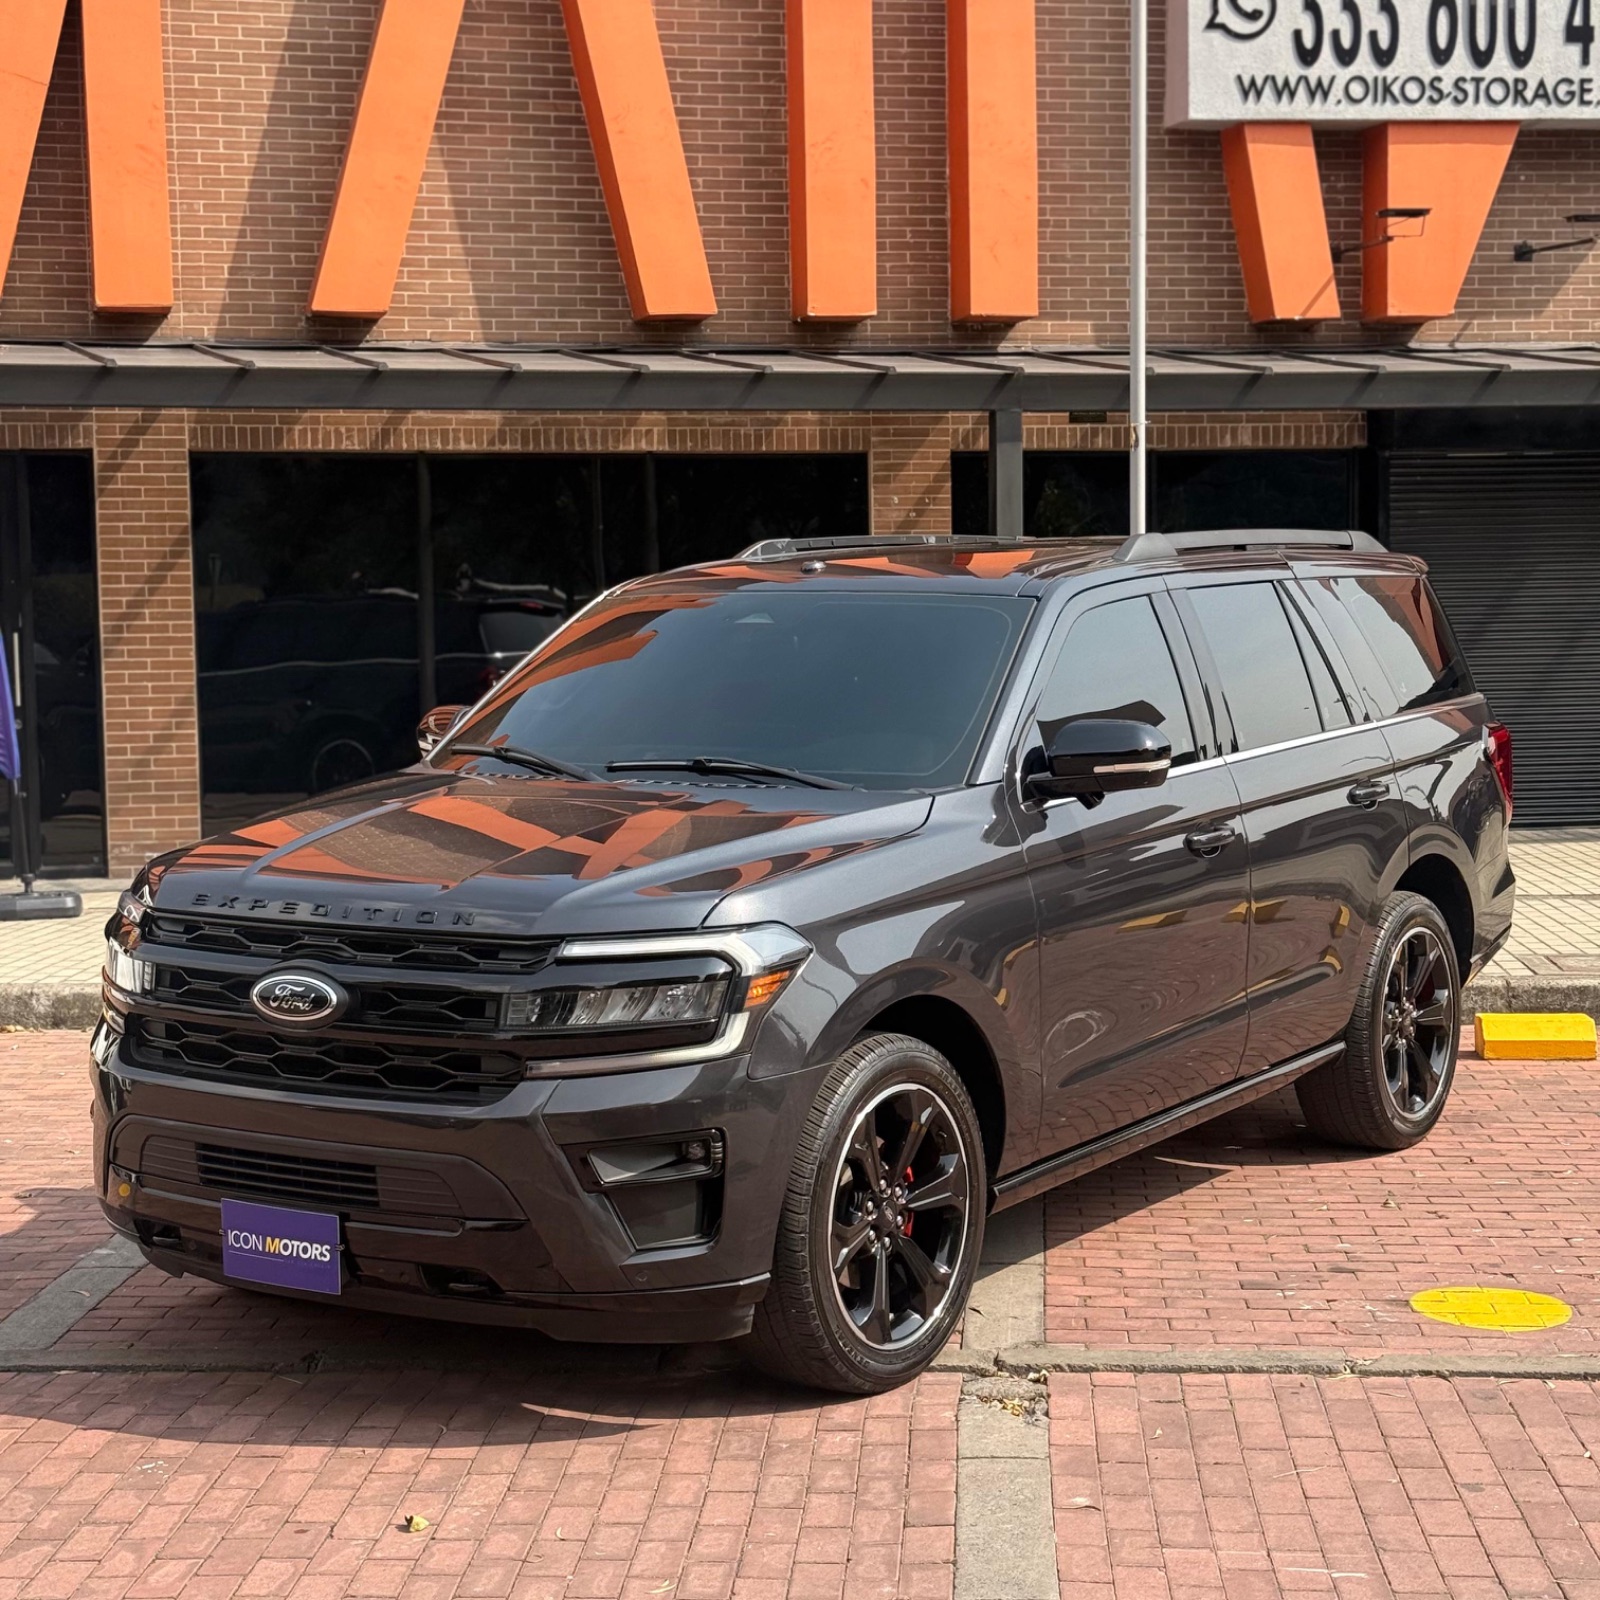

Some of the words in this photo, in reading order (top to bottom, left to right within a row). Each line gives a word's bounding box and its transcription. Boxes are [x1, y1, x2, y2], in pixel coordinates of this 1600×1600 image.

[192, 893, 476, 926] EXPEDITION
[269, 984, 314, 1011] Ford
[228, 1229, 263, 1252] ICON
[265, 1236, 331, 1262] MOTORS
